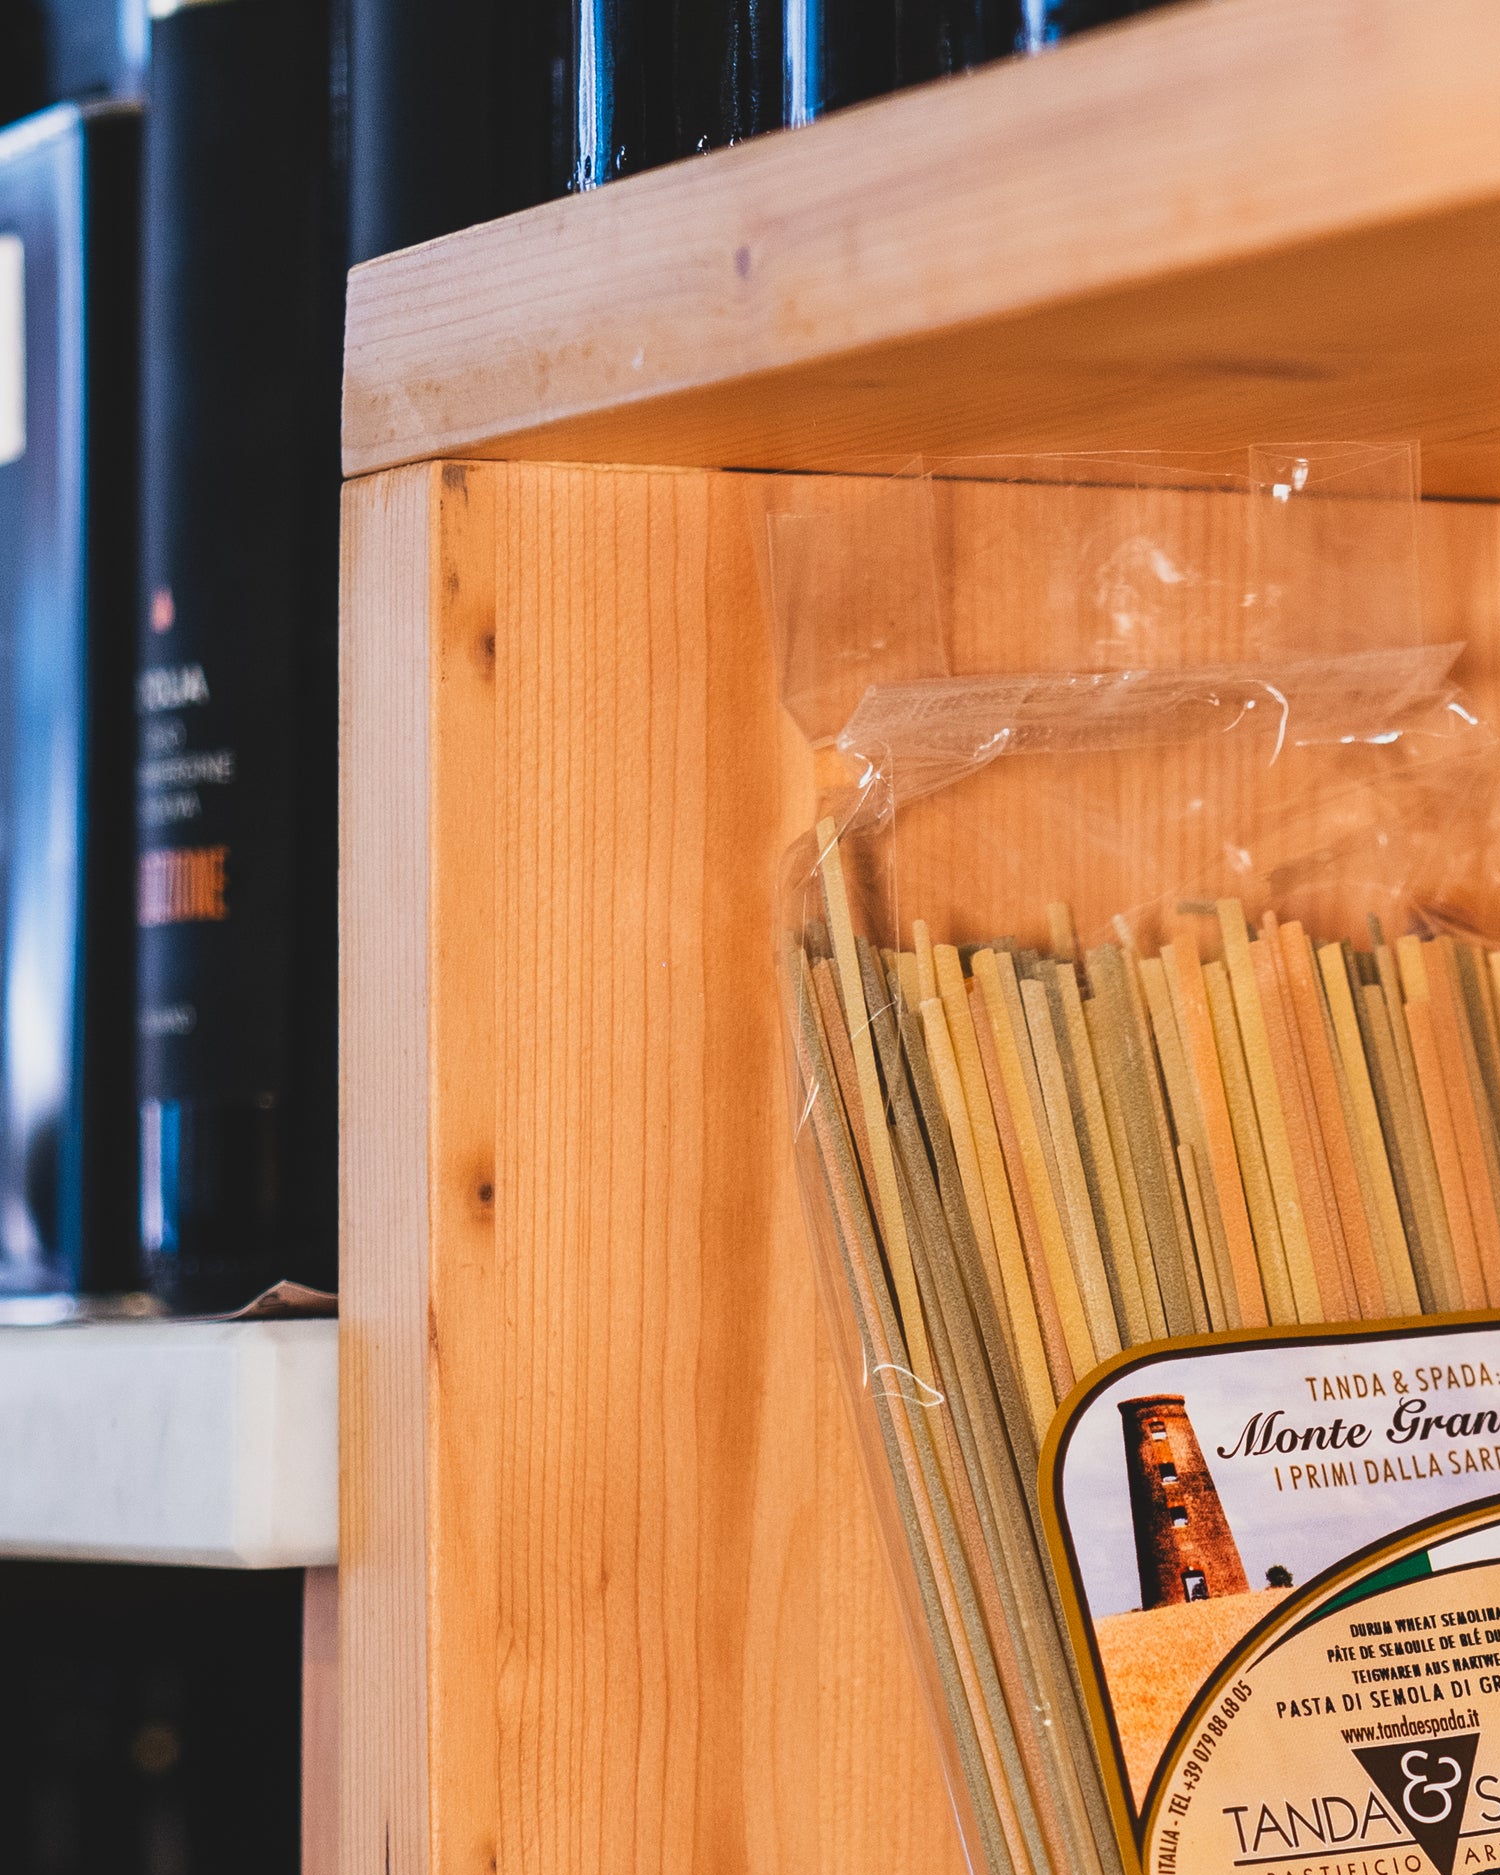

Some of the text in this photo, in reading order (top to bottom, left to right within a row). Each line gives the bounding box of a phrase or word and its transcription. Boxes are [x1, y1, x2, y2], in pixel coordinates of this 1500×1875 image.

[1305, 1363, 1500, 1400] TANDA & SPADA:
[1217, 1410, 1371, 1458] Monte
[1275, 1467, 1281, 1490] I
[1290, 1462, 1356, 1489] PRIMI
[1364, 1453, 1442, 1483] DALLA
[1350, 1621, 1392, 1637] DURUM
[1395, 1615, 1436, 1632] WHEAT
[1327, 1645, 1355, 1662] PÂTE
[1379, 1638, 1435, 1656] SEMOULE
[1459, 1628, 1481, 1646] BLÉ
[1352, 1660, 1449, 1683] TEIGWAREN AUS
[1232, 1680, 1251, 1701] 05
[1276, 1696, 1335, 1718] PASTA
[1342, 1693, 1361, 1711] DI
[1370, 1683, 1444, 1707] SEMOLA
[1450, 1679, 1470, 1697] DI
[1220, 1697, 1238, 1718] 68
[1207, 1715, 1226, 1736] 88
[1341, 1708, 1479, 1742] www.tandaespada.it
[1193, 1733, 1215, 1761] 079
[1184, 1761, 1202, 1788] +39
[1168, 1795, 1190, 1815] TEL
[1222, 1791, 1400, 1853] TANDA
[1403, 1749, 1460, 1822] &
[1158, 1830, 1179, 1874] ITALIA
